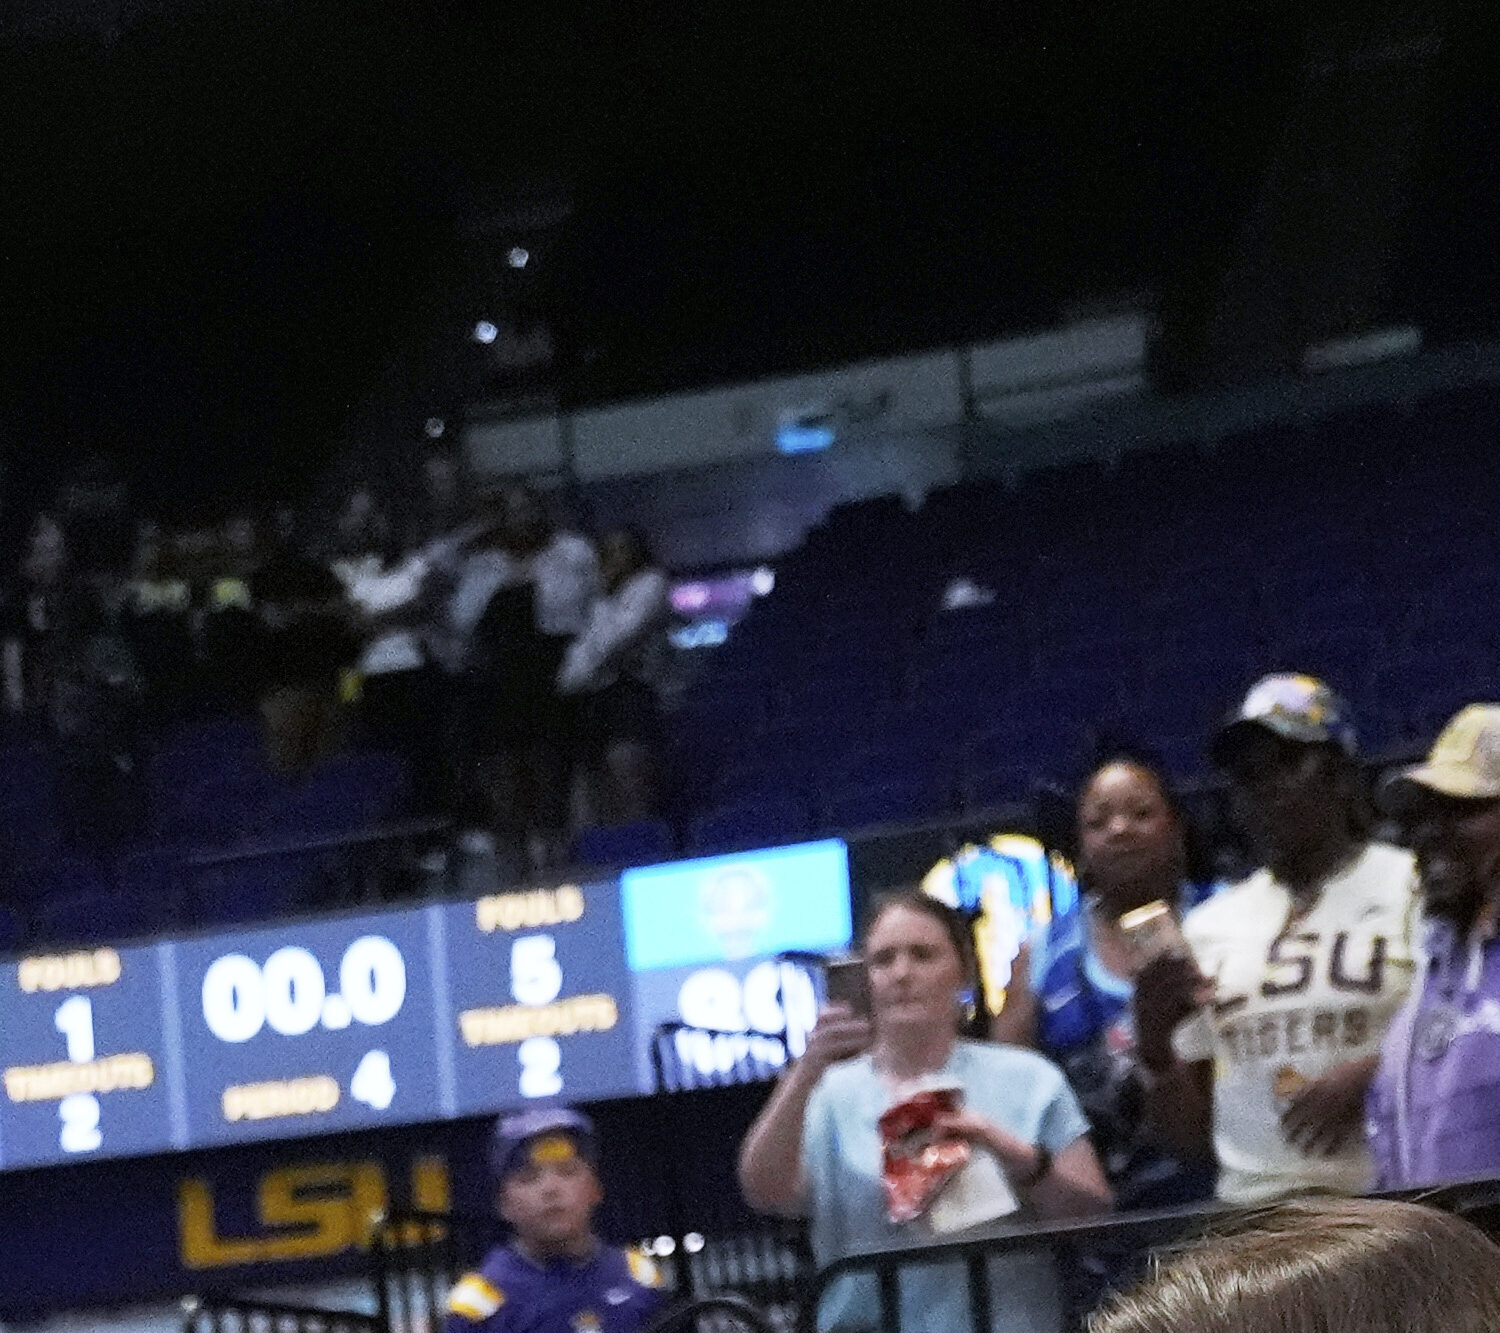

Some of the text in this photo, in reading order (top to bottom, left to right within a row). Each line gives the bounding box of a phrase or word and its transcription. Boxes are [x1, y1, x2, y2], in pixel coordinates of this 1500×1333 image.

[202, 935, 406, 1043] 00.0
[511, 934, 562, 1006] 5
[55, 995, 94, 1063] 1
[351, 1050, 396, 1110] 4
[518, 1037, 563, 1098] 2
[60, 1093, 103, 1152] 2
